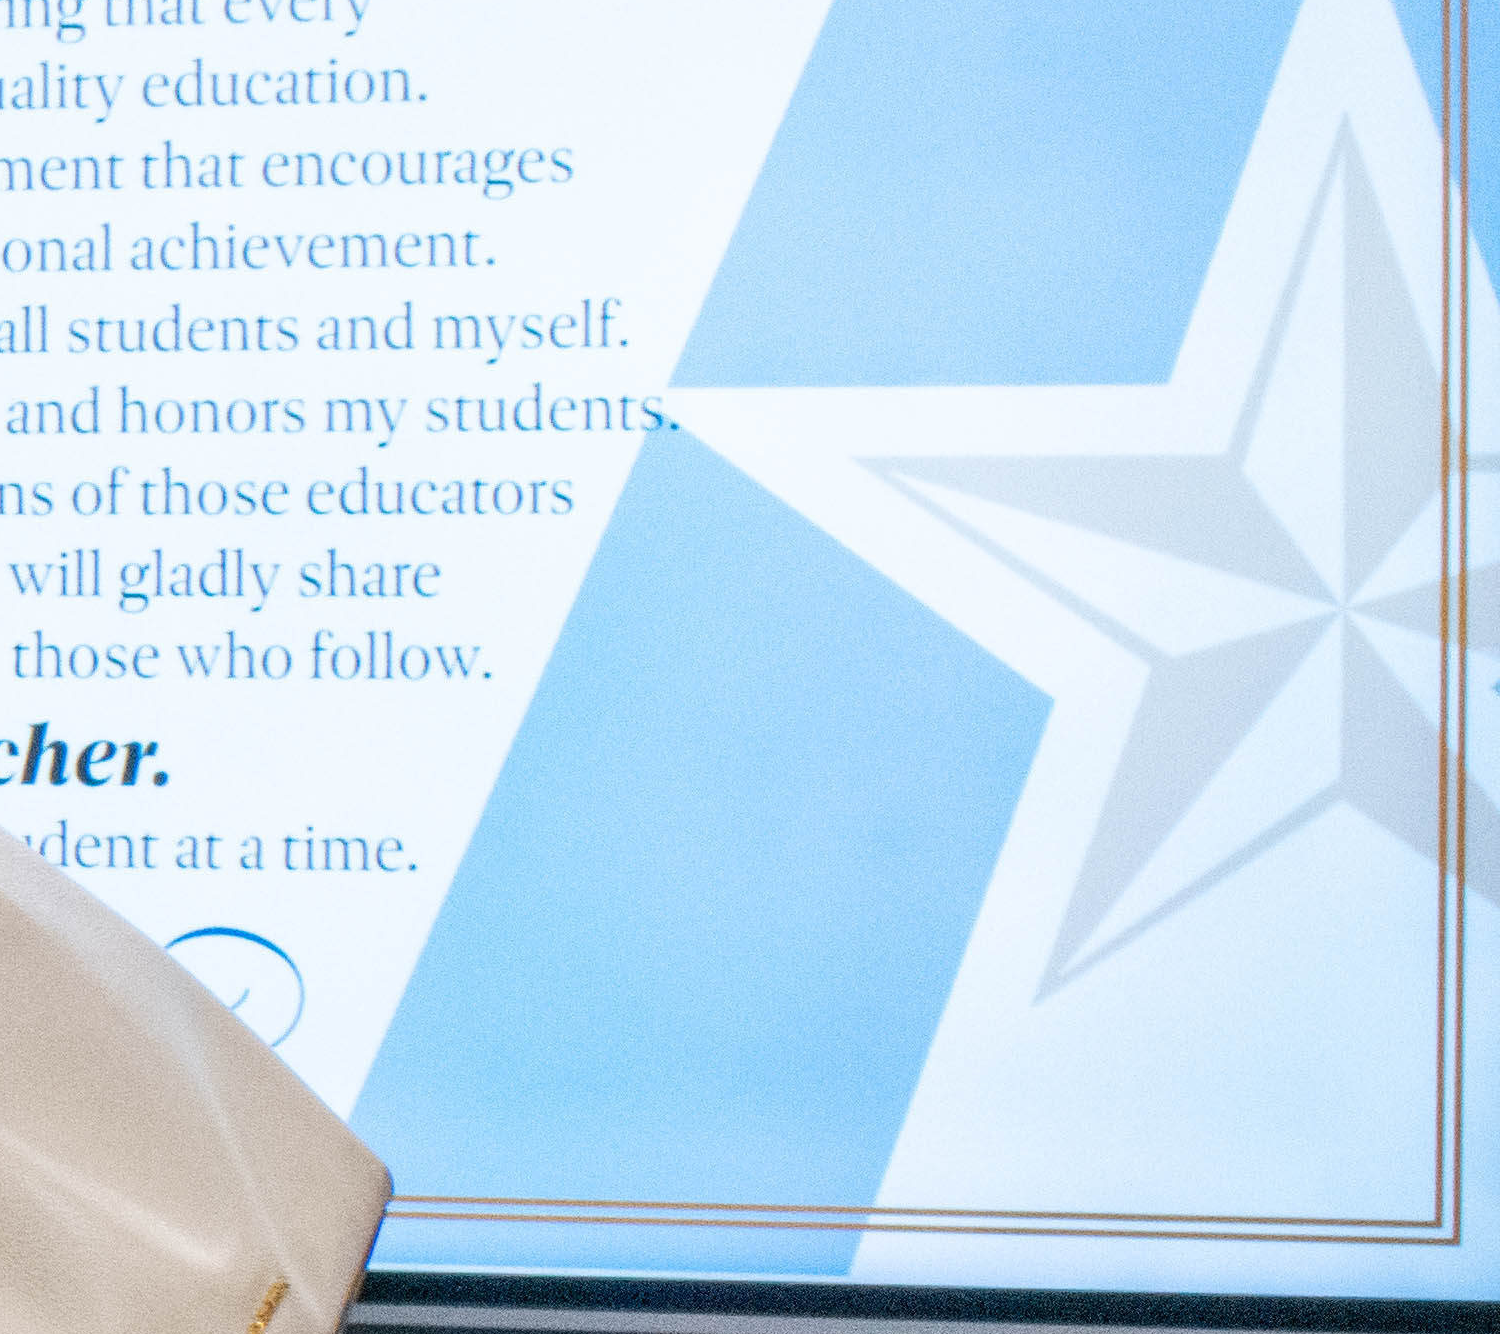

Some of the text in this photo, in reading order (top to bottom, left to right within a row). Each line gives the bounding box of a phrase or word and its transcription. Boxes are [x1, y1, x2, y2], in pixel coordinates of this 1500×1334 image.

[141, 56, 428, 109] education.
[140, 138, 245, 190] that
[261, 147, 574, 202] encourages
[129, 219, 496, 272] achievement.
[67, 301, 300, 354] students
[315, 299, 415, 351] and
[432, 296, 629, 366] myself.
[5, 383, 101, 435] and
[117, 383, 307, 434] honors
[323, 397, 408, 449] my
[425, 381, 682, 435] students.
[70, 464, 130, 517] of
[136, 465, 290, 517] those
[305, 464, 575, 517] educators
[7, 546, 102, 598] will
[117, 546, 281, 615] gladly
[298, 546, 442, 599] share
[11, 628, 161, 680] those
[175, 628, 294, 680] who
[309, 628, 493, 681] follow.
[174, 823, 223, 871] at
[238, 834, 265, 871] a
[281, 823, 418, 873] time.
